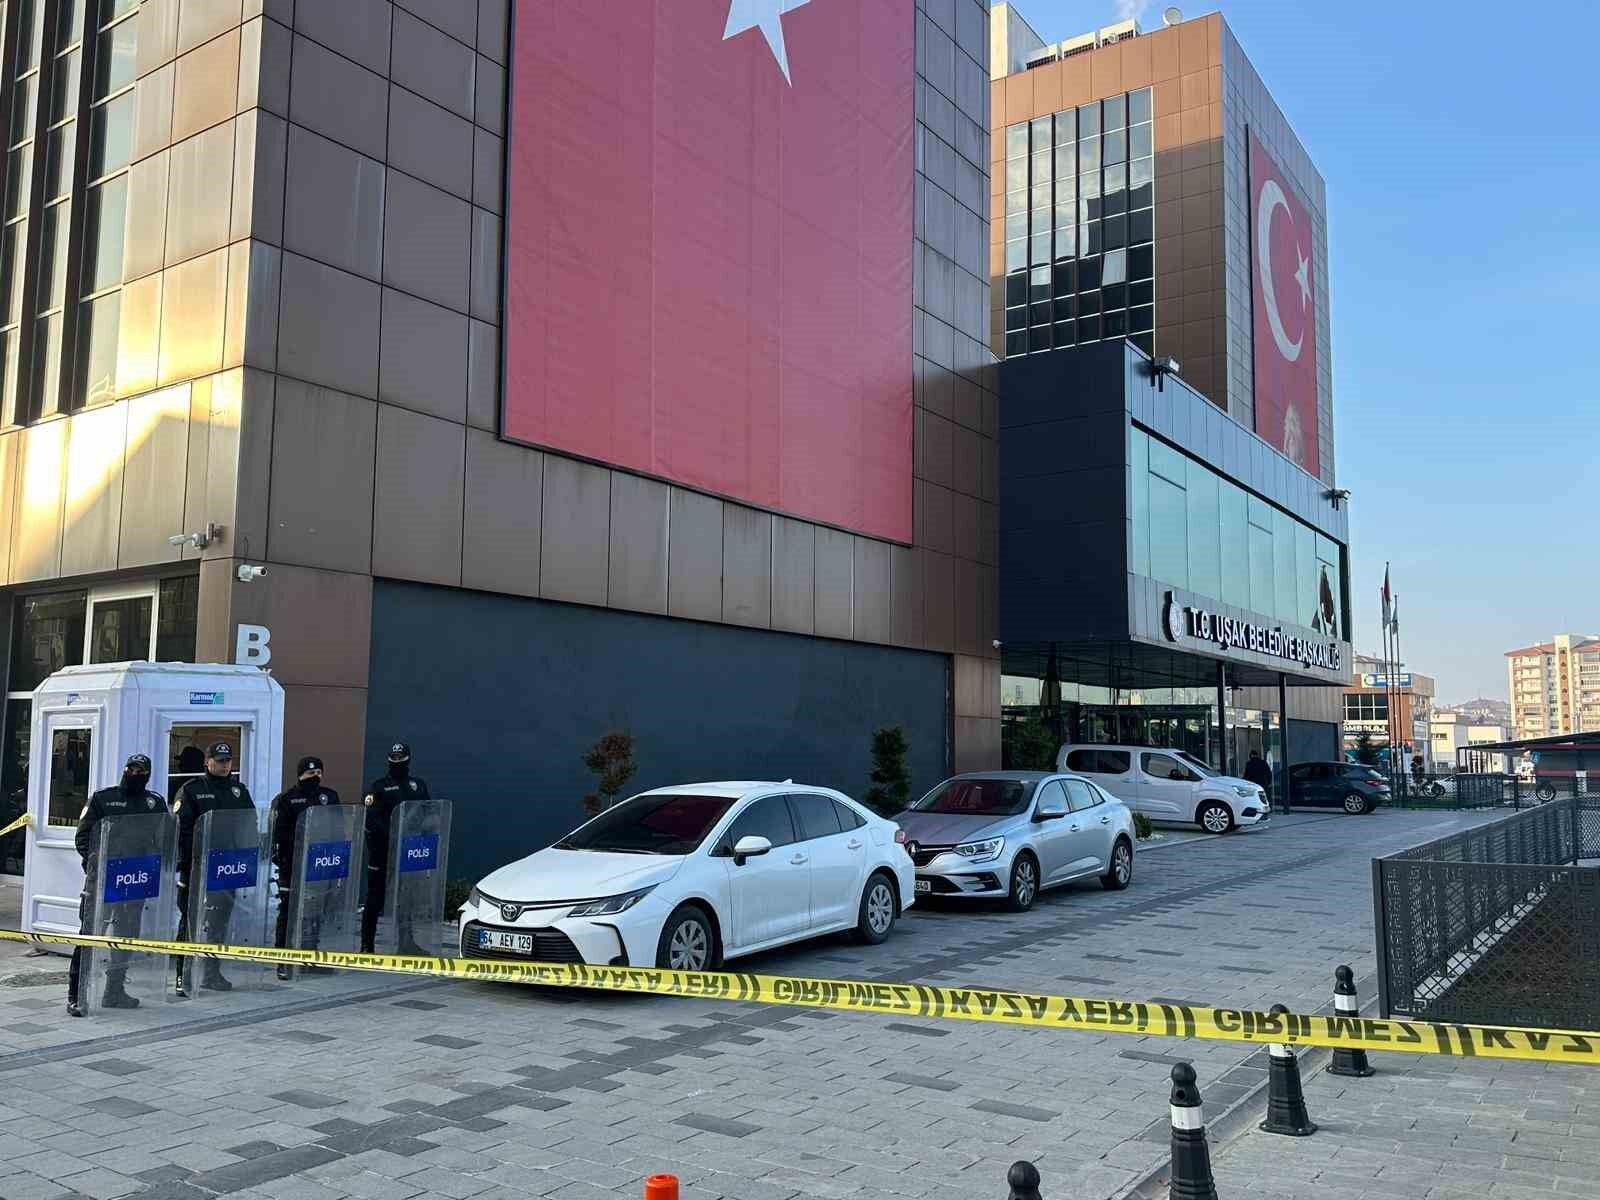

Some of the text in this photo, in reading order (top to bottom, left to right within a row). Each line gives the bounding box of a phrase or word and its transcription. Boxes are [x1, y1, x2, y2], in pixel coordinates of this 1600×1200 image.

[1190, 607, 1213, 640] T.C.
[1216, 615, 1248, 649] UŞAK
[1250, 625, 1295, 658] BELEDİYE
[235, 623, 271, 666] B
[315, 854, 341, 868] POLİS
[407, 847, 430, 859] POLİS
[217, 861, 247, 877] POLİS
[115, 869, 149, 887] POLİS
[518, 936, 530, 949] 129
